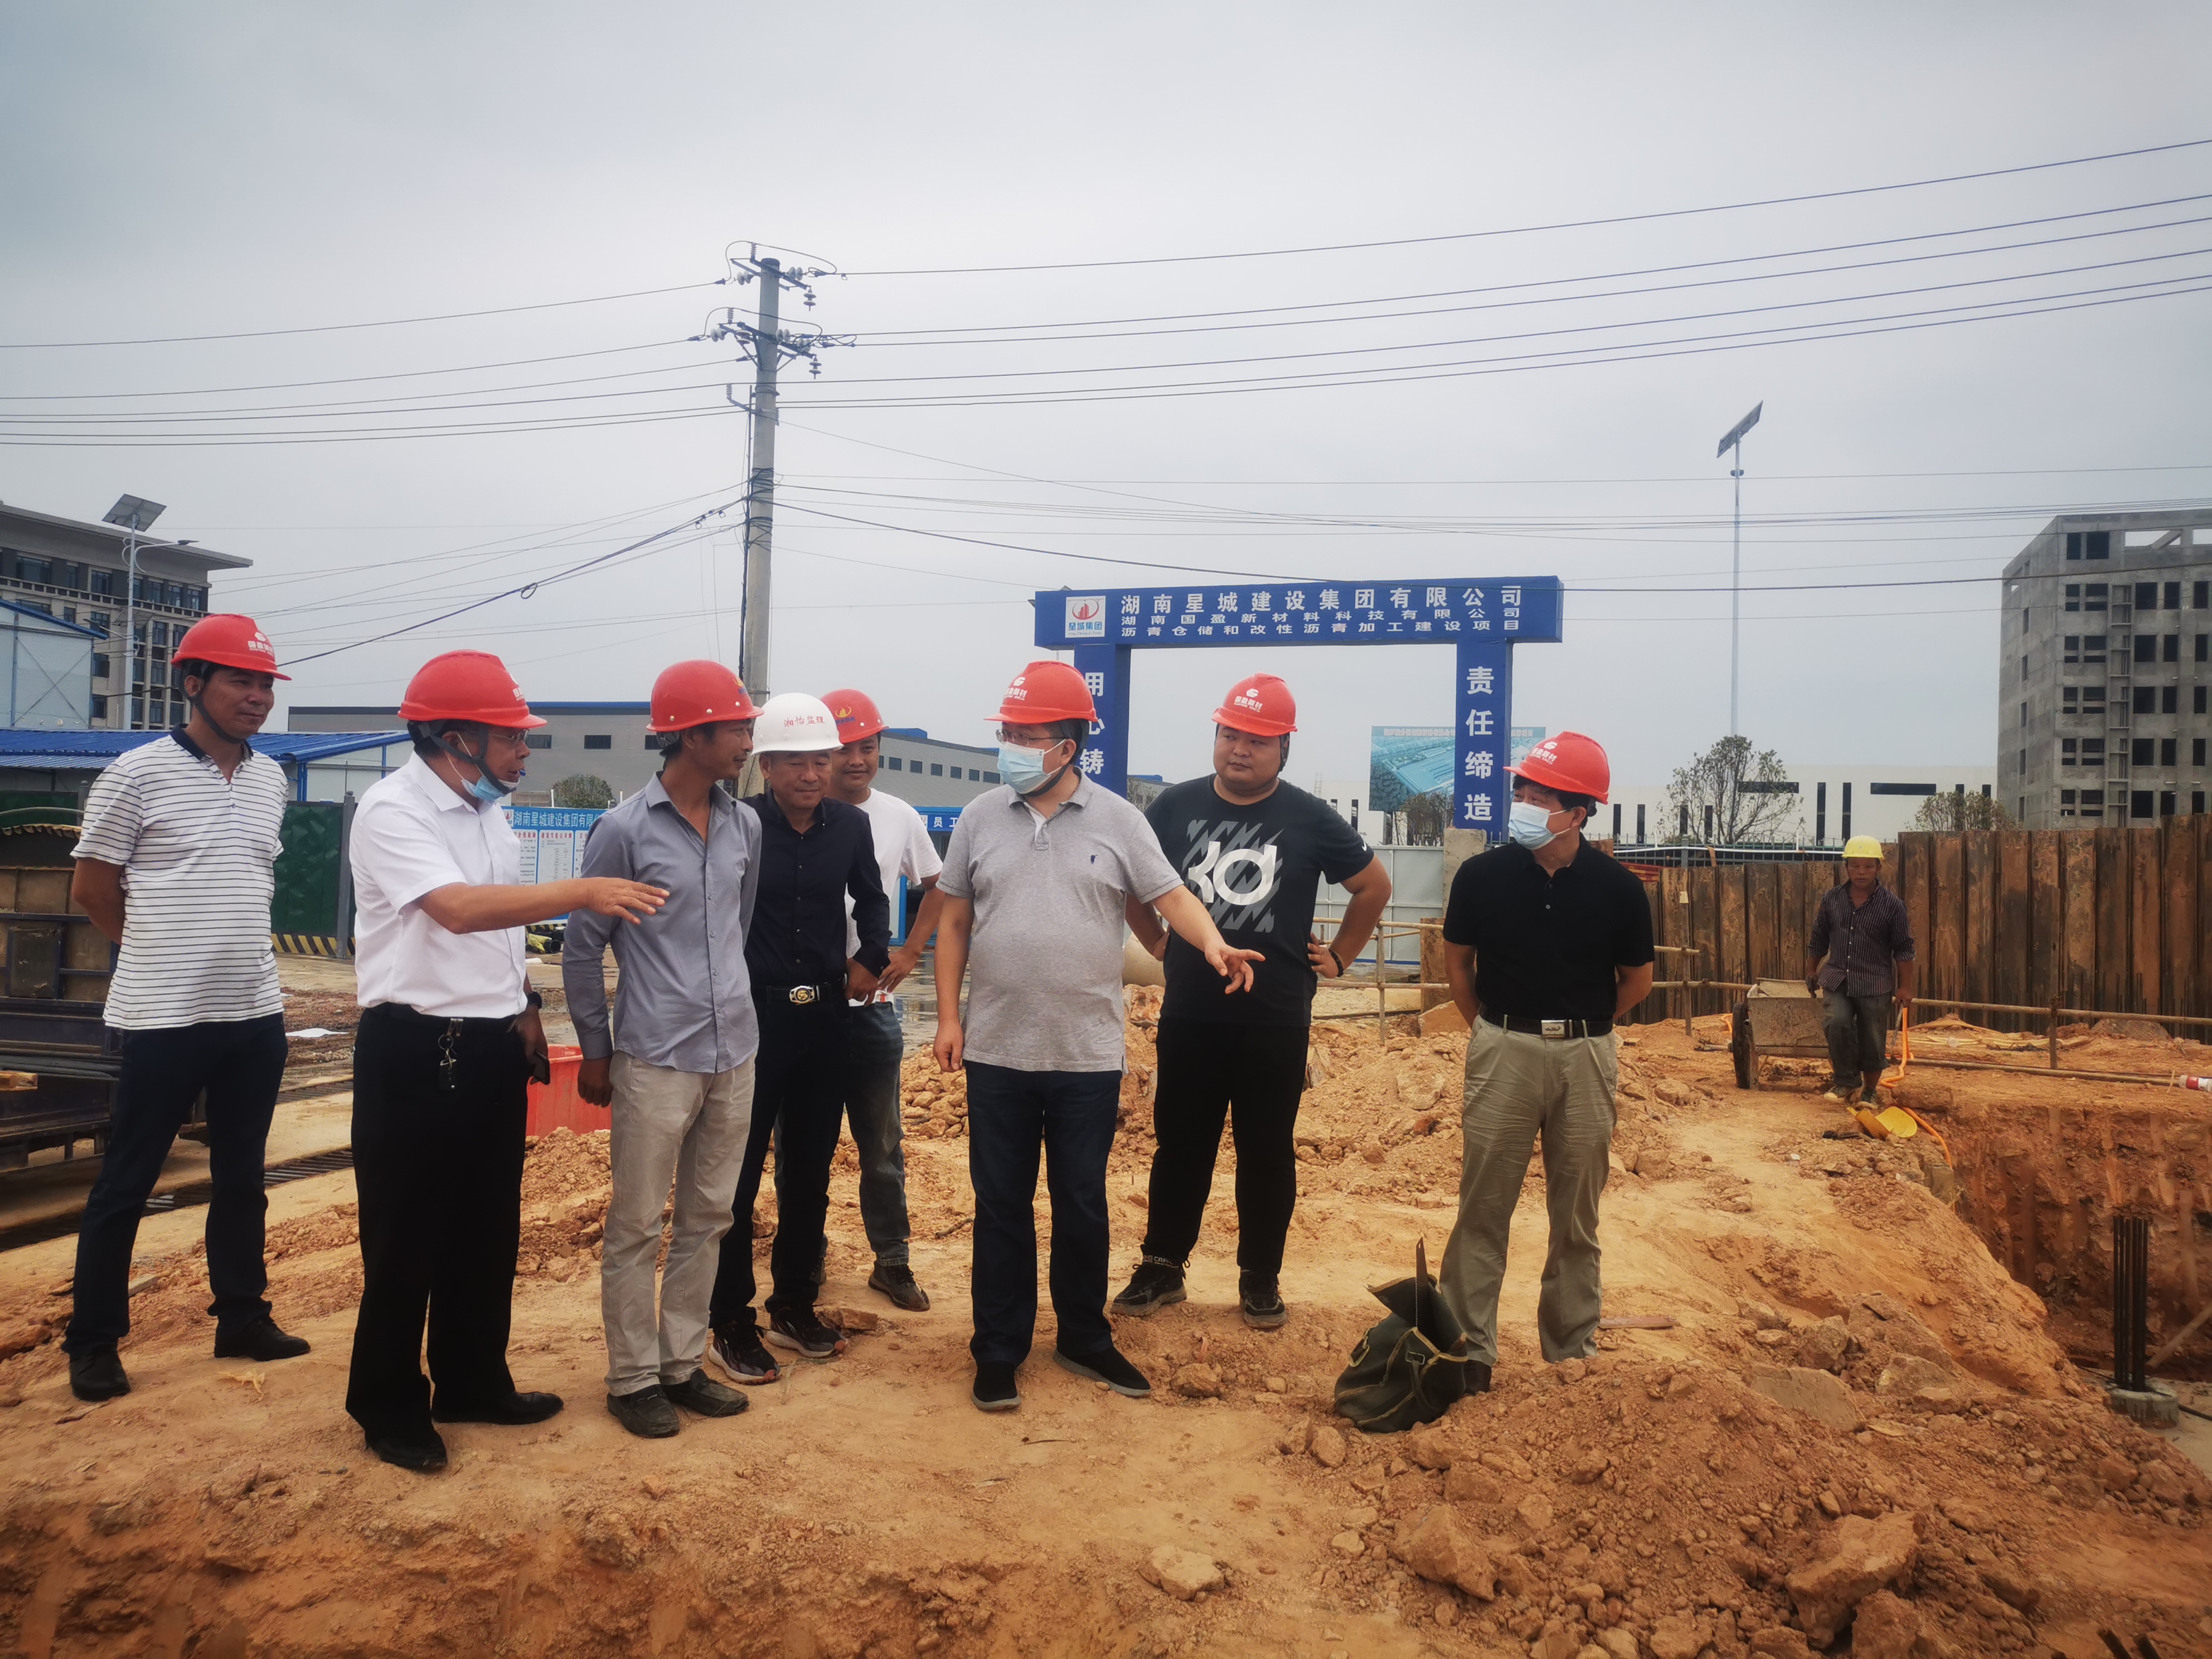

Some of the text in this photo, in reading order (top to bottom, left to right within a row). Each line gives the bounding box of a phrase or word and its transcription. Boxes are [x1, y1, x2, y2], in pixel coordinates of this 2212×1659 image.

[1121, 585, 1522, 614] 湖南星城建设集团有限公司
[1121, 608, 1520, 626] 湖南国盈新材料科技有限公司
[1121, 620, 1520, 637] 沥青仓储和改性沥青加工建设项目
[1464, 666, 1495, 821] 责任缔造
